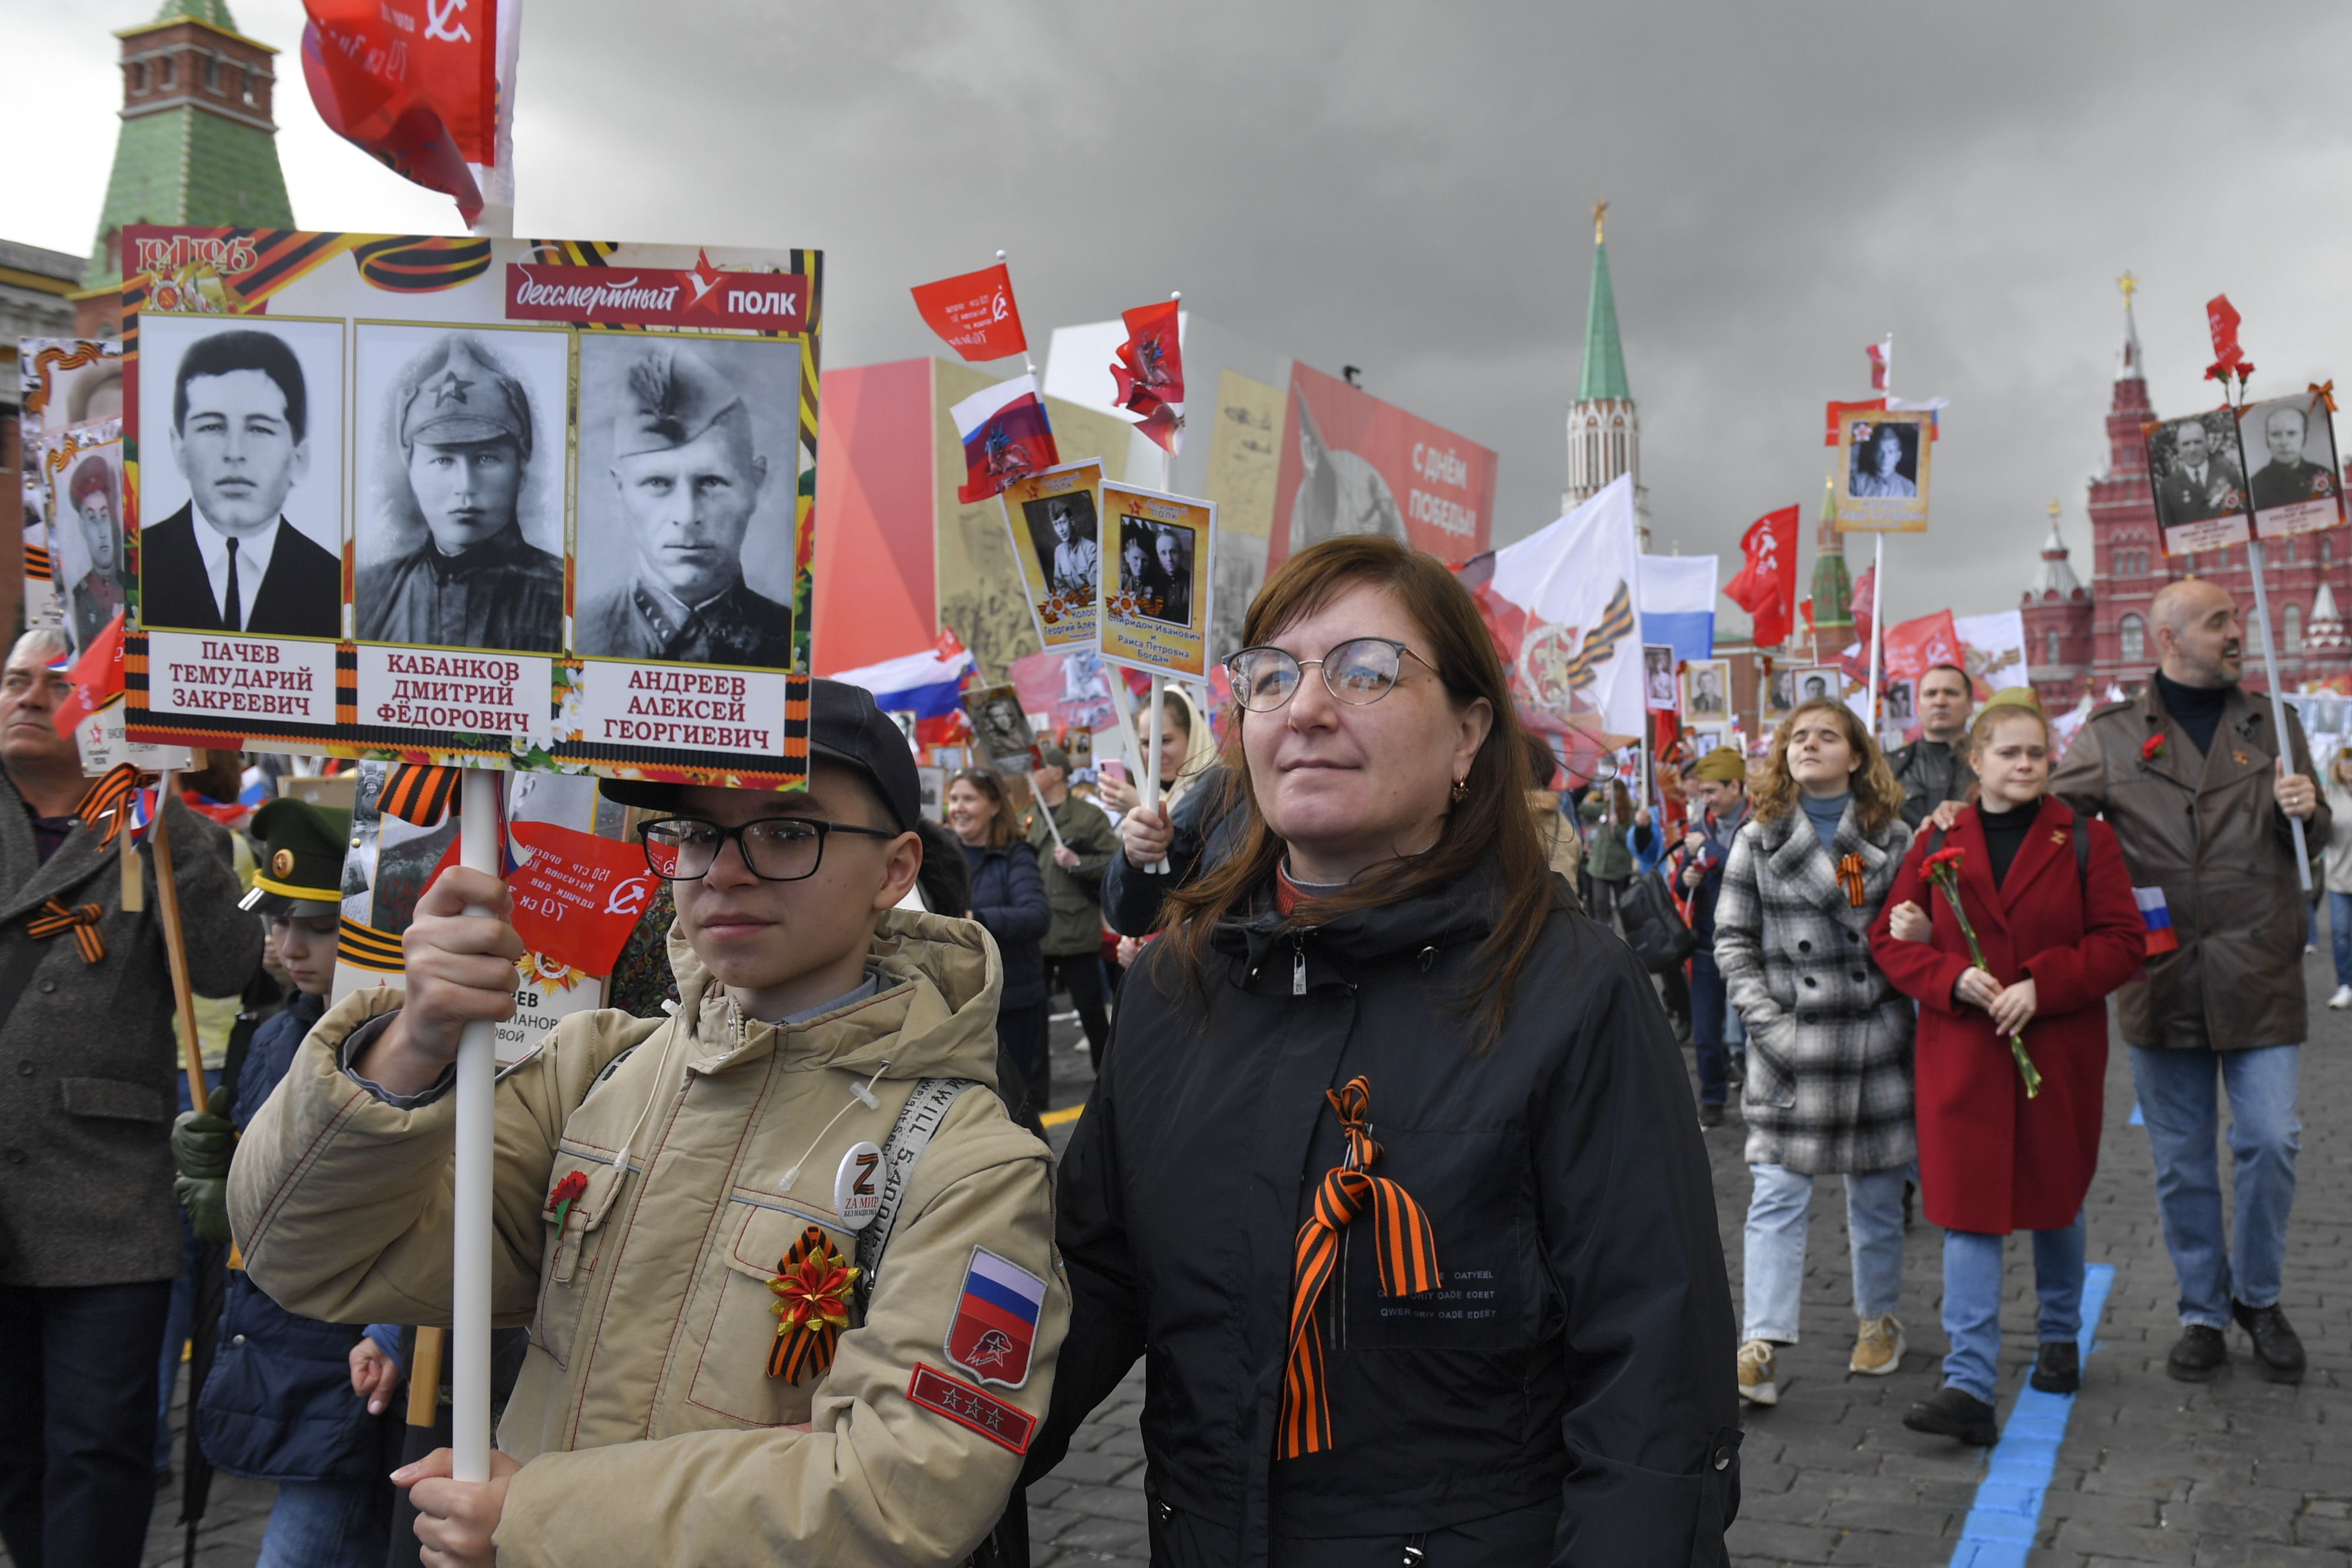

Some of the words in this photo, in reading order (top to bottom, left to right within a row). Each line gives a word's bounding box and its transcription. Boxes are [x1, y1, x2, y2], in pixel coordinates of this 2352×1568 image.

[728, 290, 796, 315] ПОЛК
[1409, 488, 1477, 538] ПОБЕДЫ!
[1108, 613, 1153, 630] Спиридон
[1155, 624, 1201, 641] Иванович
[202, 641, 279, 664] ПАЧЕВ
[1118, 635, 1144, 648] Раиса
[1146, 641, 1190, 659] Петровна
[1137, 650, 1169, 663] Богдан
[169, 663, 313, 691] ТЕМУДАРИЙ
[387, 654, 519, 681] КАБАНКОВ
[392, 680, 513, 706] ДМИТРИЙ
[628, 670, 746, 696] АНДРЕЕВ
[172, 688, 310, 716] ЗАКРЕЕВИЧ
[627, 696, 745, 722] АЛЕКСЕЙ
[377, 700, 529, 732] ФЁДОРОВИЧ
[604, 719, 769, 749] ГЕОРГИЕВИЧ
[908, 1089, 953, 1134] WILL
[853, 1153, 879, 1196] Z
[854, 1209, 877, 1217] НАЦИЗМА
[860, 1197, 879, 1209] МИР
[1381, 1308, 1411, 1316] QWER
